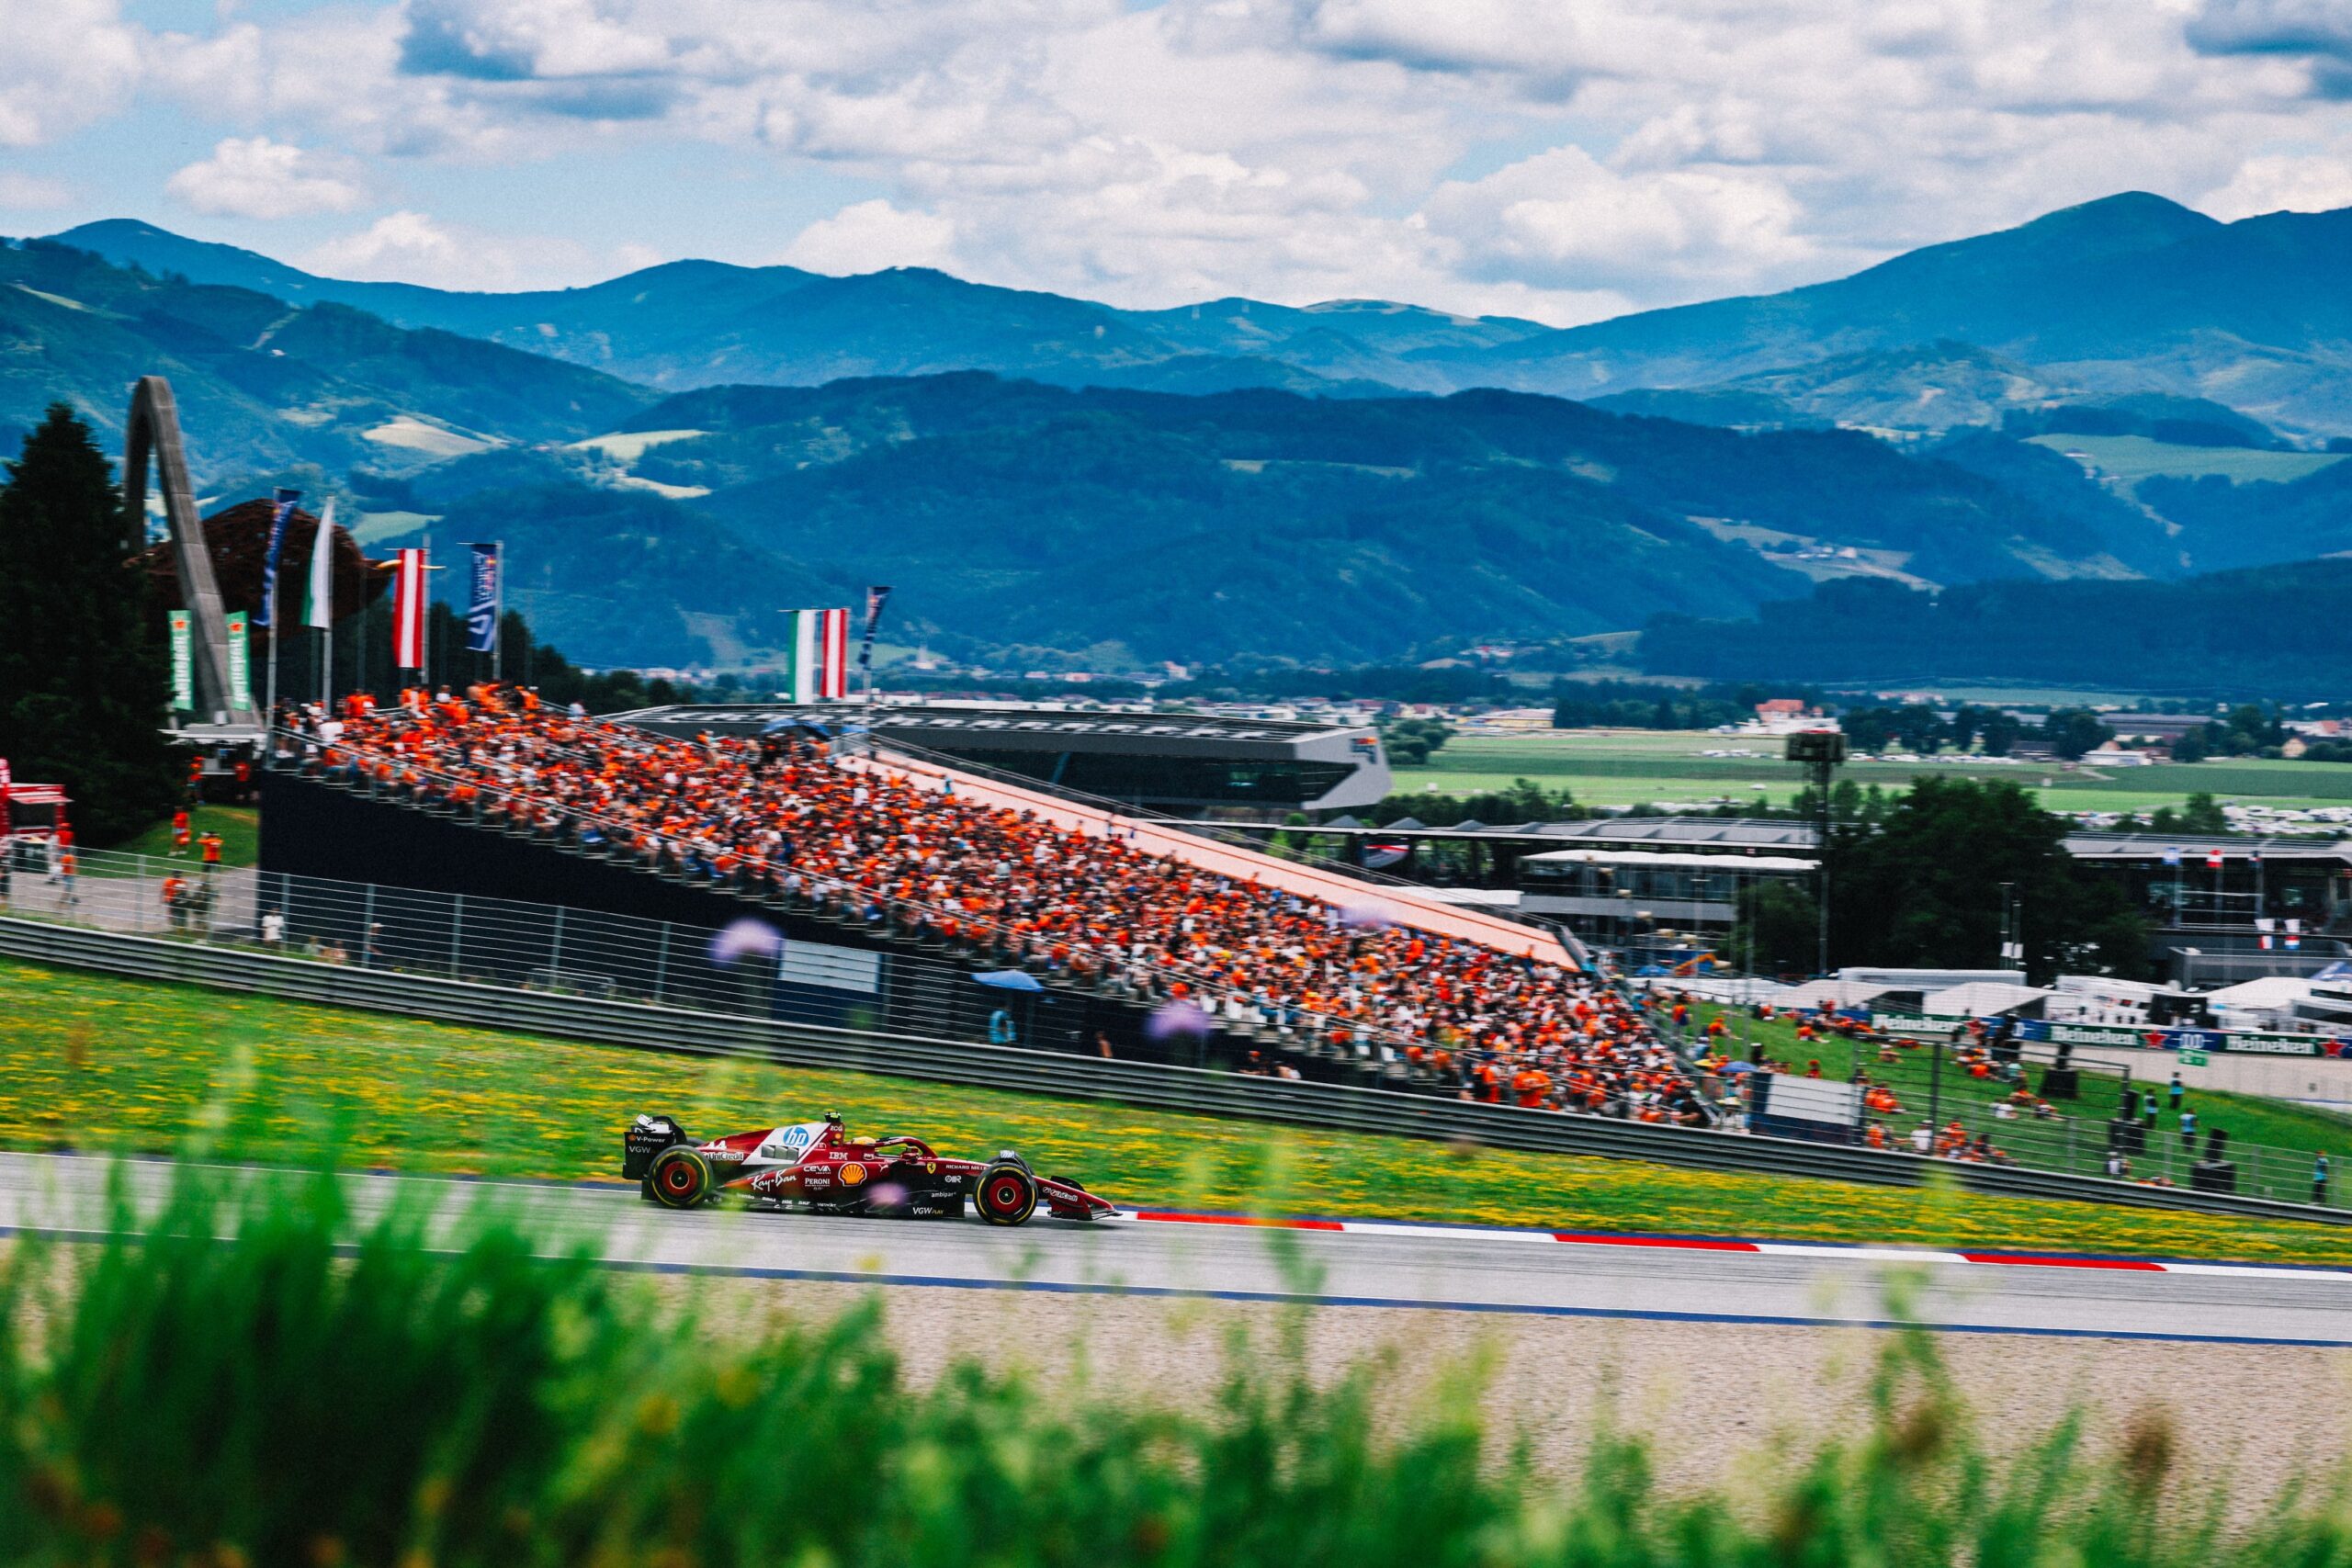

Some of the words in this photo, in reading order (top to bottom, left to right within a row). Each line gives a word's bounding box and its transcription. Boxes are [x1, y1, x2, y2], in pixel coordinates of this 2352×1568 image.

[2050, 1025, 2138, 1045] Heineken
[2225, 1035, 2315, 1054] Heineken
[628, 1145, 650, 1154] VGW
[829, 1152, 848, 1160] IBM
